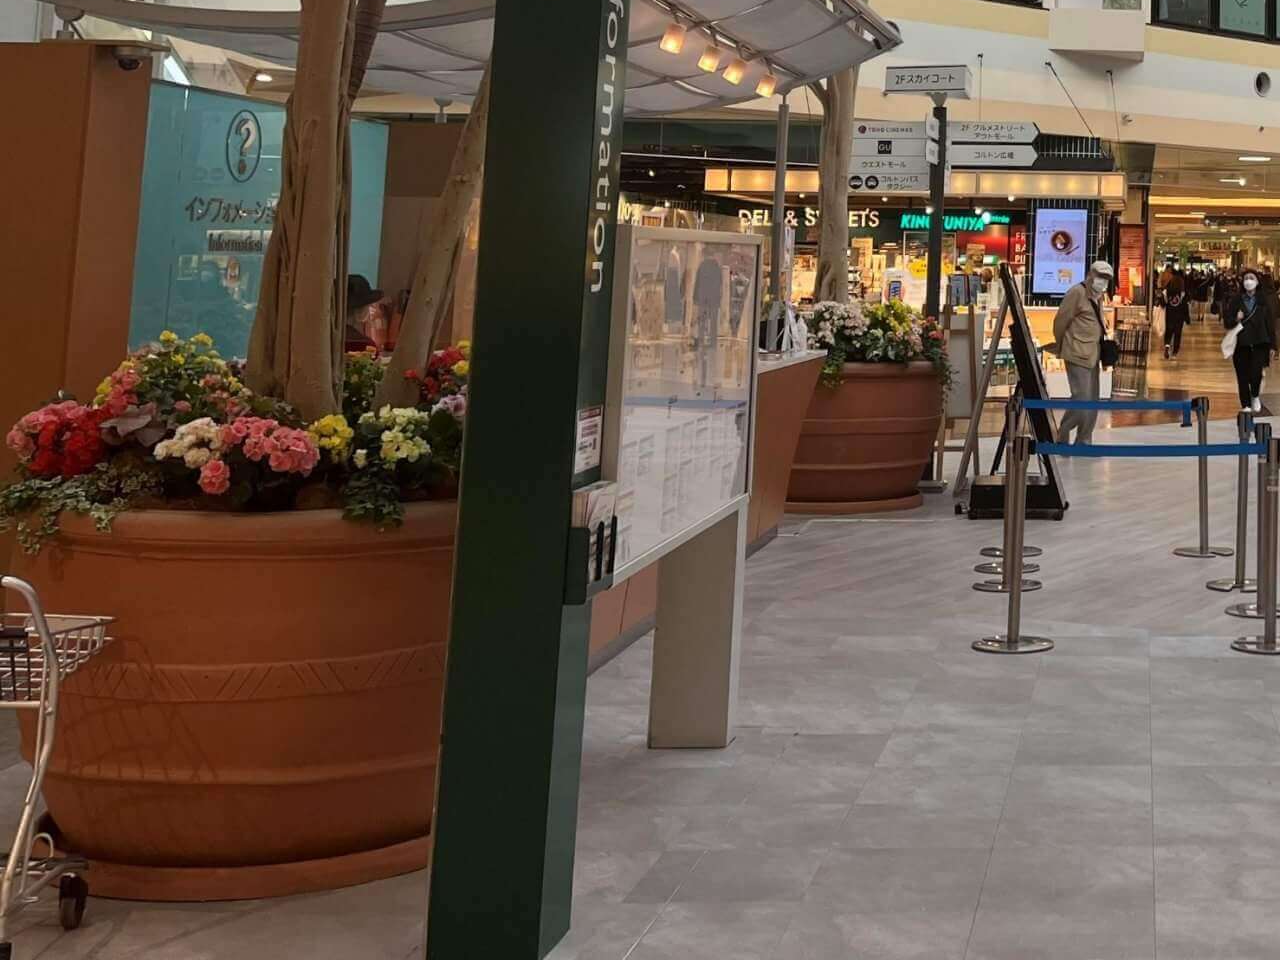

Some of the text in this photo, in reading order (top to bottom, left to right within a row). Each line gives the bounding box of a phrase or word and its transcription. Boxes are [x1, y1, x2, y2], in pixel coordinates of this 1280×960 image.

[184, 195, 279, 225] インフォメーショ
[738, 208, 880, 228] DEL & SETS
[900, 214, 985, 232] KINUNIYA
